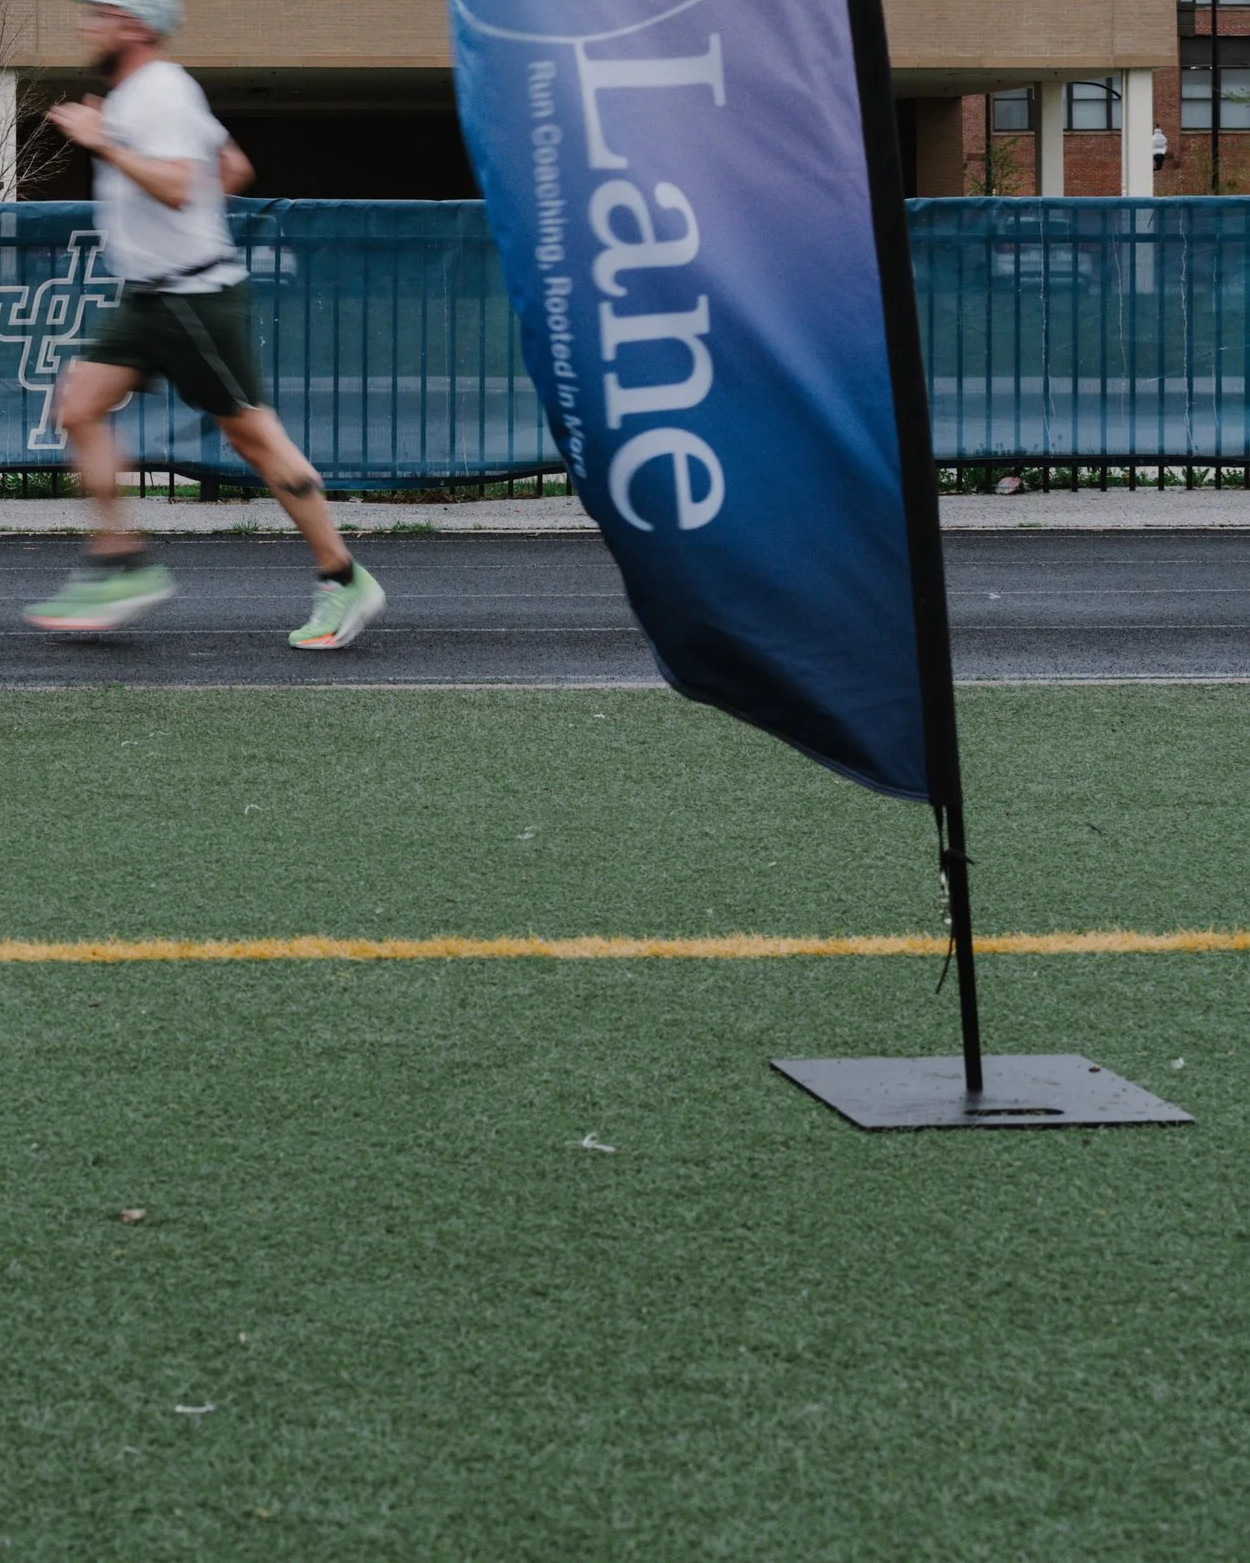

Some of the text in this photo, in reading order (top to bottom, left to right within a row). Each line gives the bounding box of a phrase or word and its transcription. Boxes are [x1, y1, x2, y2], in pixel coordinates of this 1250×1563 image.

[527, 60, 588, 480] Run Coaching, Rooted in More
[574, 32, 726, 532] Lane
